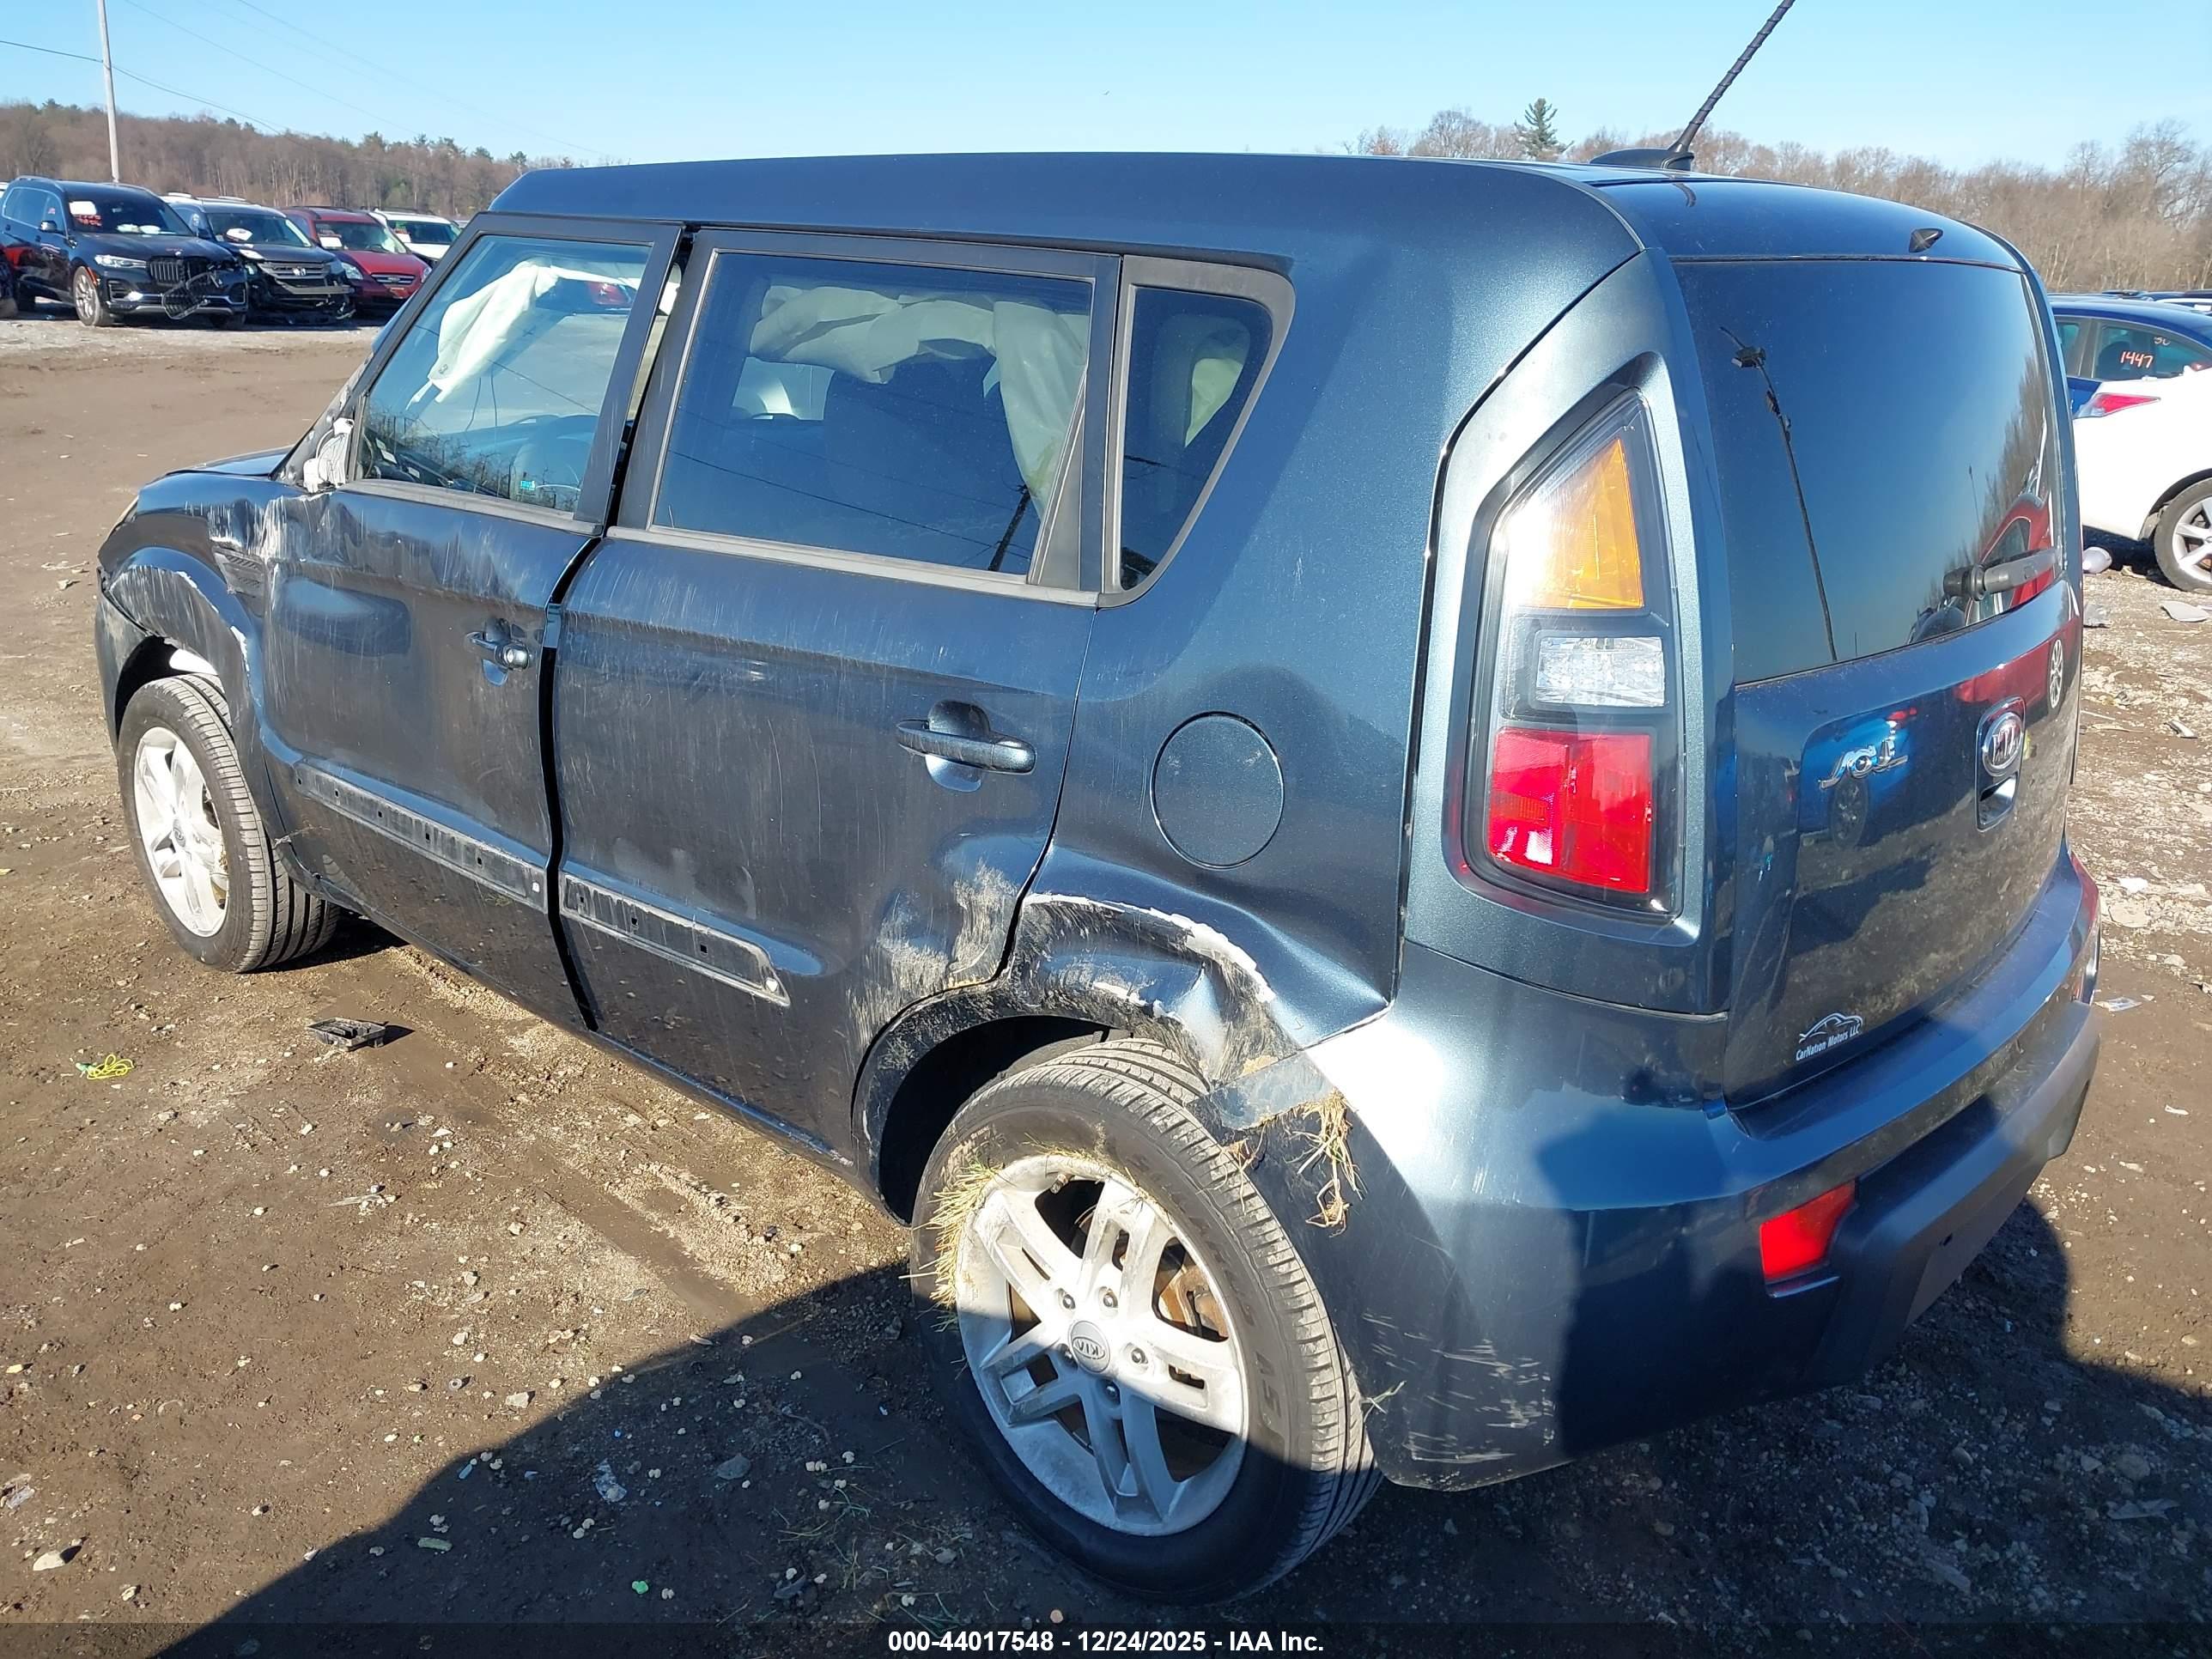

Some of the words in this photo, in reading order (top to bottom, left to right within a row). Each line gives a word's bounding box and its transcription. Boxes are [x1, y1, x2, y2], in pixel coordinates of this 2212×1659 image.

[2121, 350, 2154, 368] 1447
[1991, 722, 2019, 756] KIA
[1828, 1031, 1848, 1047] Motors
[1850, 1023, 1861, 1037] LLC
[1074, 1338, 1103, 1358] KIA
